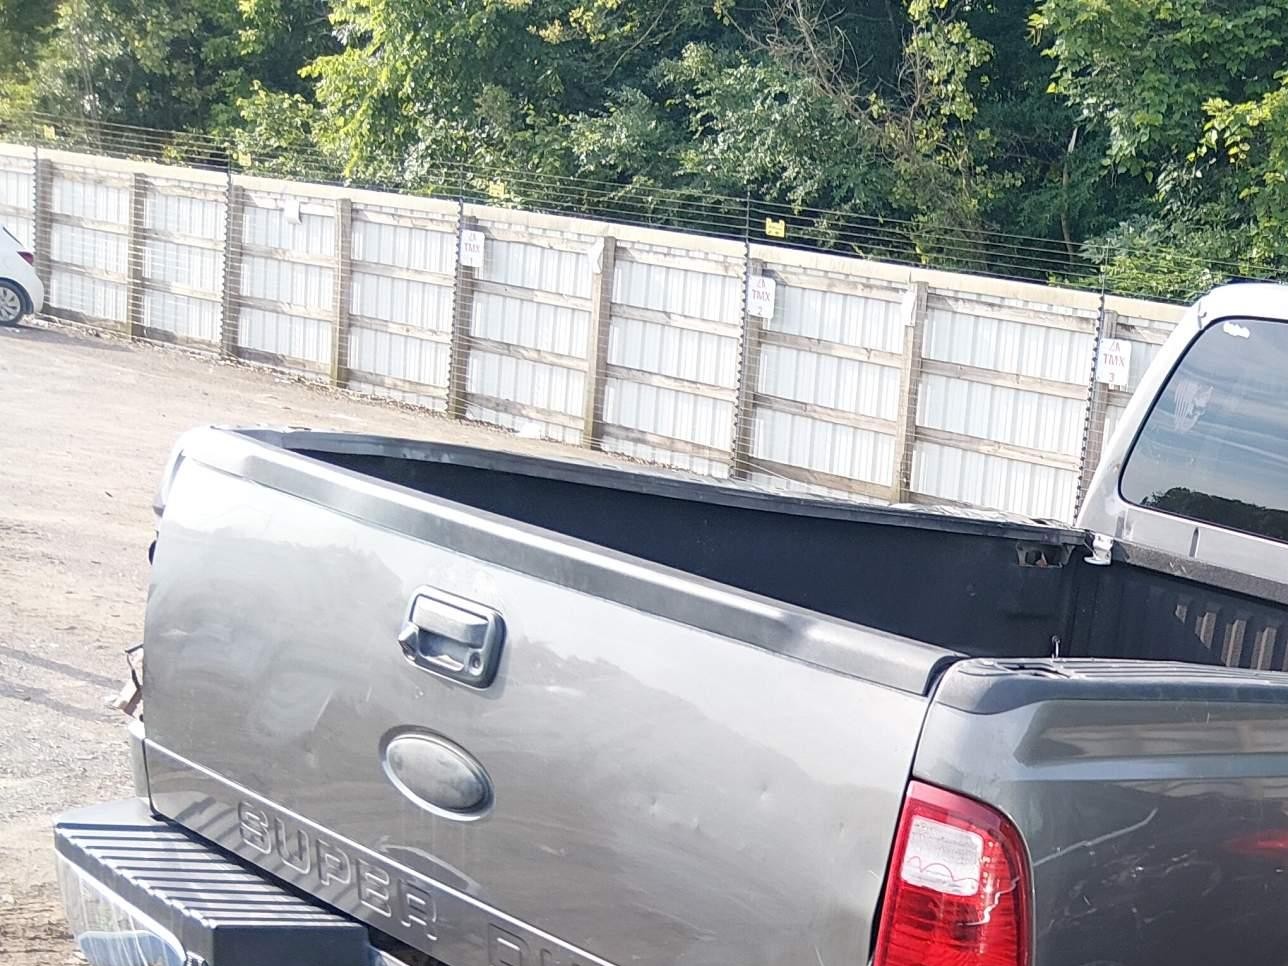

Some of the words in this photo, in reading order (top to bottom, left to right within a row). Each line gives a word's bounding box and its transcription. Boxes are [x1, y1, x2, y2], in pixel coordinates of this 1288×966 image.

[752, 289, 771, 302] TMX
[1103, 353, 1126, 368] TMX
[237, 800, 438, 941] SUPER
